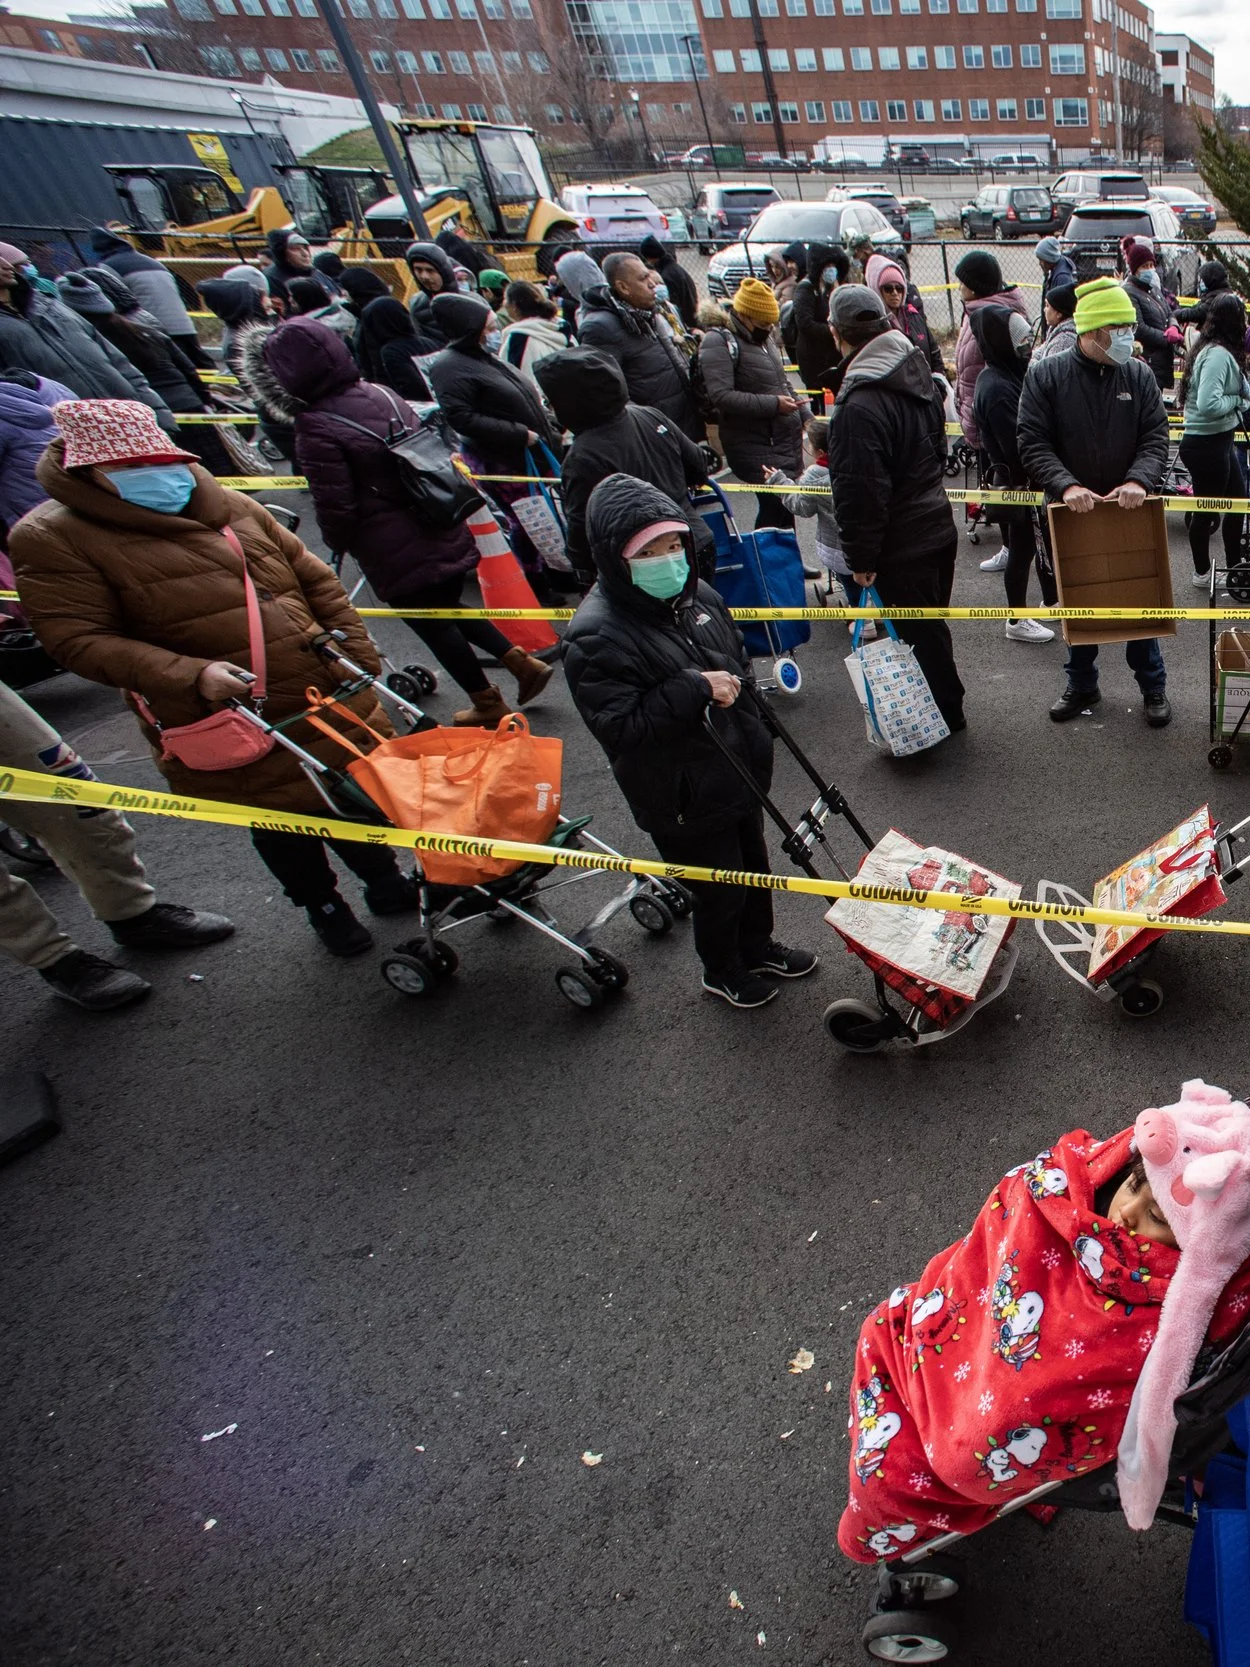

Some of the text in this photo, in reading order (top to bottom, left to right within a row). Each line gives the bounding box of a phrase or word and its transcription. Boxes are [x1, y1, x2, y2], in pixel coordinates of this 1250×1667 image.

[1001, 492, 1037, 502] CAUTION
[1196, 498, 1232, 510] CUIDADO
[414, 836, 494, 857] CAUTION
[710, 868, 789, 890] CAUTION
[849, 882, 928, 904] CUIDADO
[1008, 900, 1086, 917] CAUTION
